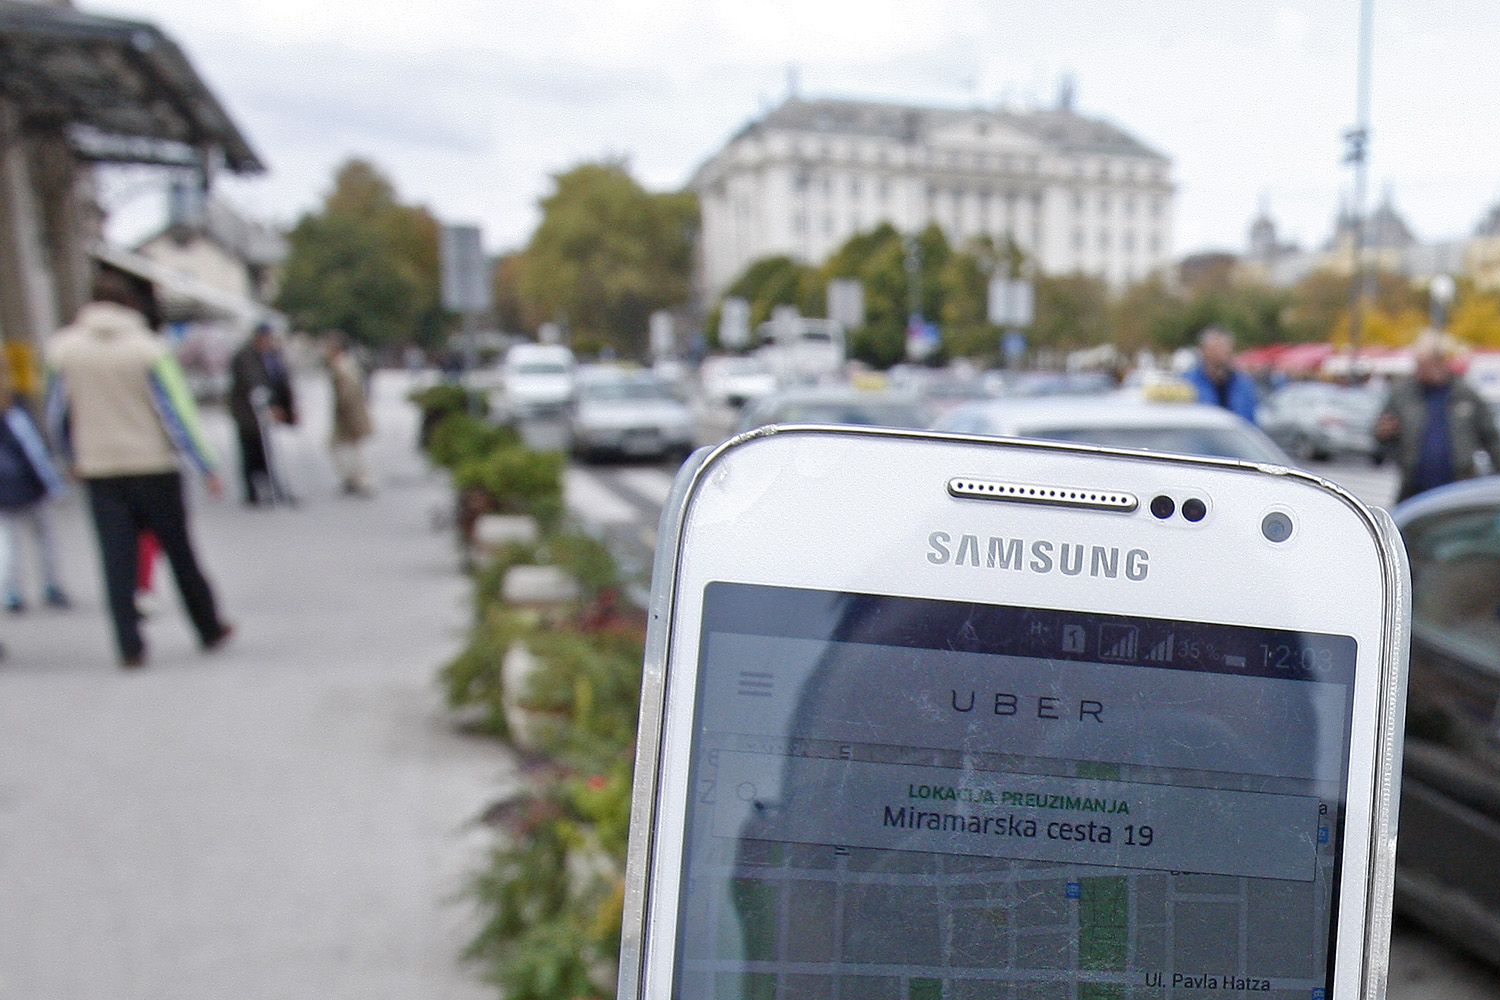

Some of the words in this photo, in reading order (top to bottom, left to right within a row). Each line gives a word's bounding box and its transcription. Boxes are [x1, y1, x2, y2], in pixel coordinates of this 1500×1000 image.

[926, 531, 1150, 581] SAMSUNG
[951, 689, 1105, 724] UBER
[1001, 790, 1131, 815] PREUZIMANJA
[882, 805, 1037, 838] Miramarska
[1047, 820, 1112, 844] cesta
[1124, 825, 1154, 847] 19
[1172, 973, 1218, 990] Pavla
[1222, 975, 1271, 992] Hatza
